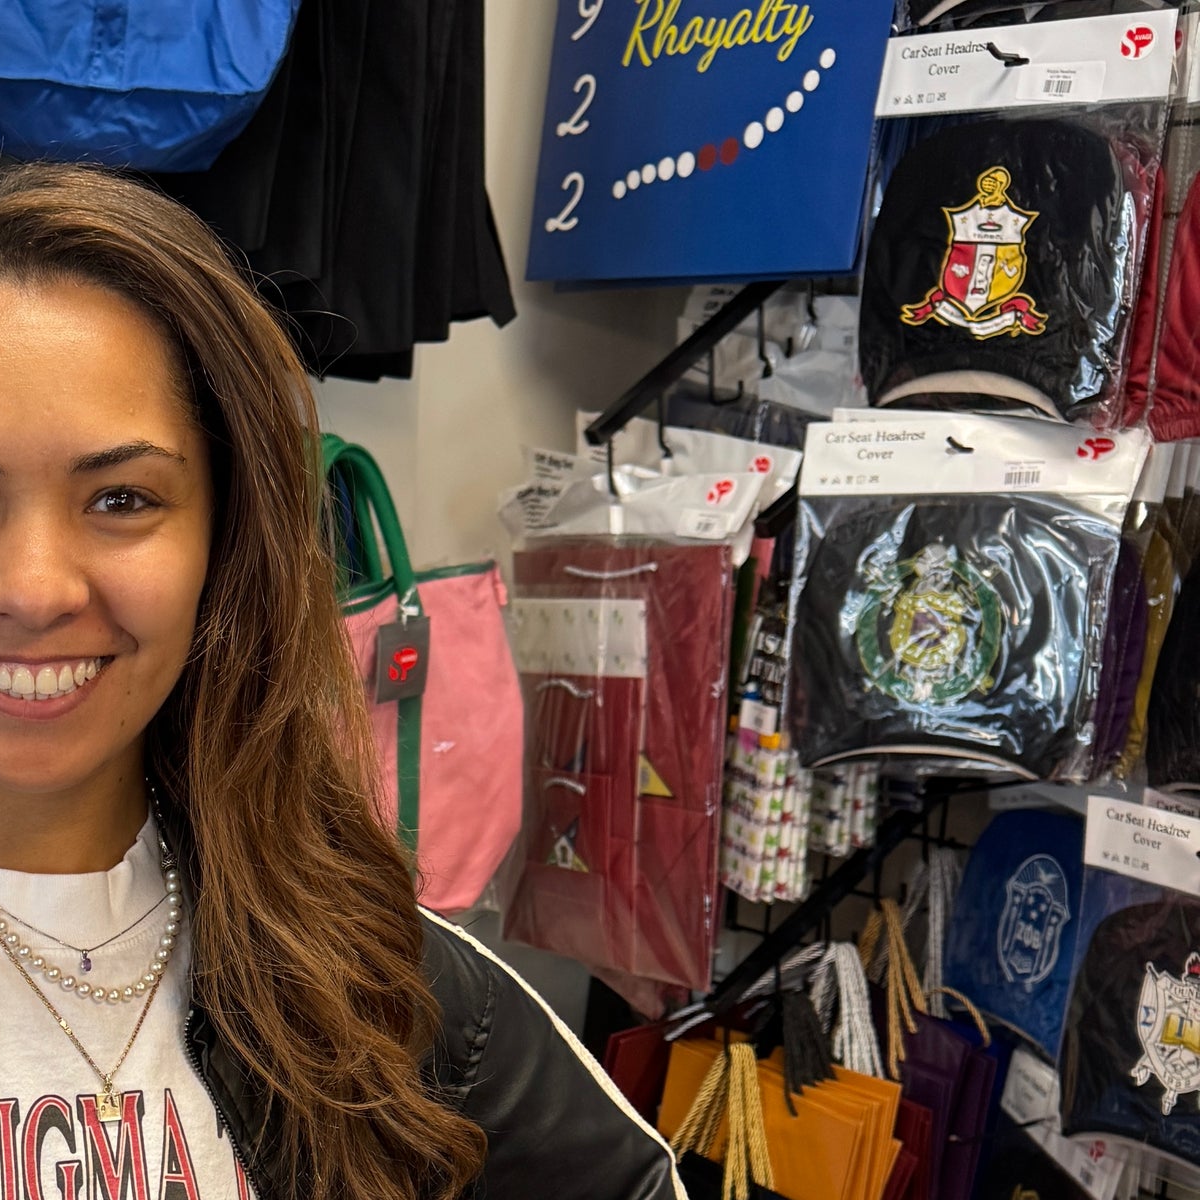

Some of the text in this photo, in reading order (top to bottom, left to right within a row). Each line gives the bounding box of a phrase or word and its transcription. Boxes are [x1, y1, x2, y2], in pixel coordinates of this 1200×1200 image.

[622, 0, 814, 73] Rhoyalty
[901, 41, 989, 60] Car Seat Headres
[928, 64, 960, 77] Cover
[825, 429, 925, 444] Car Seat Headrest
[857, 448, 894, 461] Cover
[1106, 807, 1191, 840] Car Seat Headrest
[1133, 831, 1162, 850] Cover
